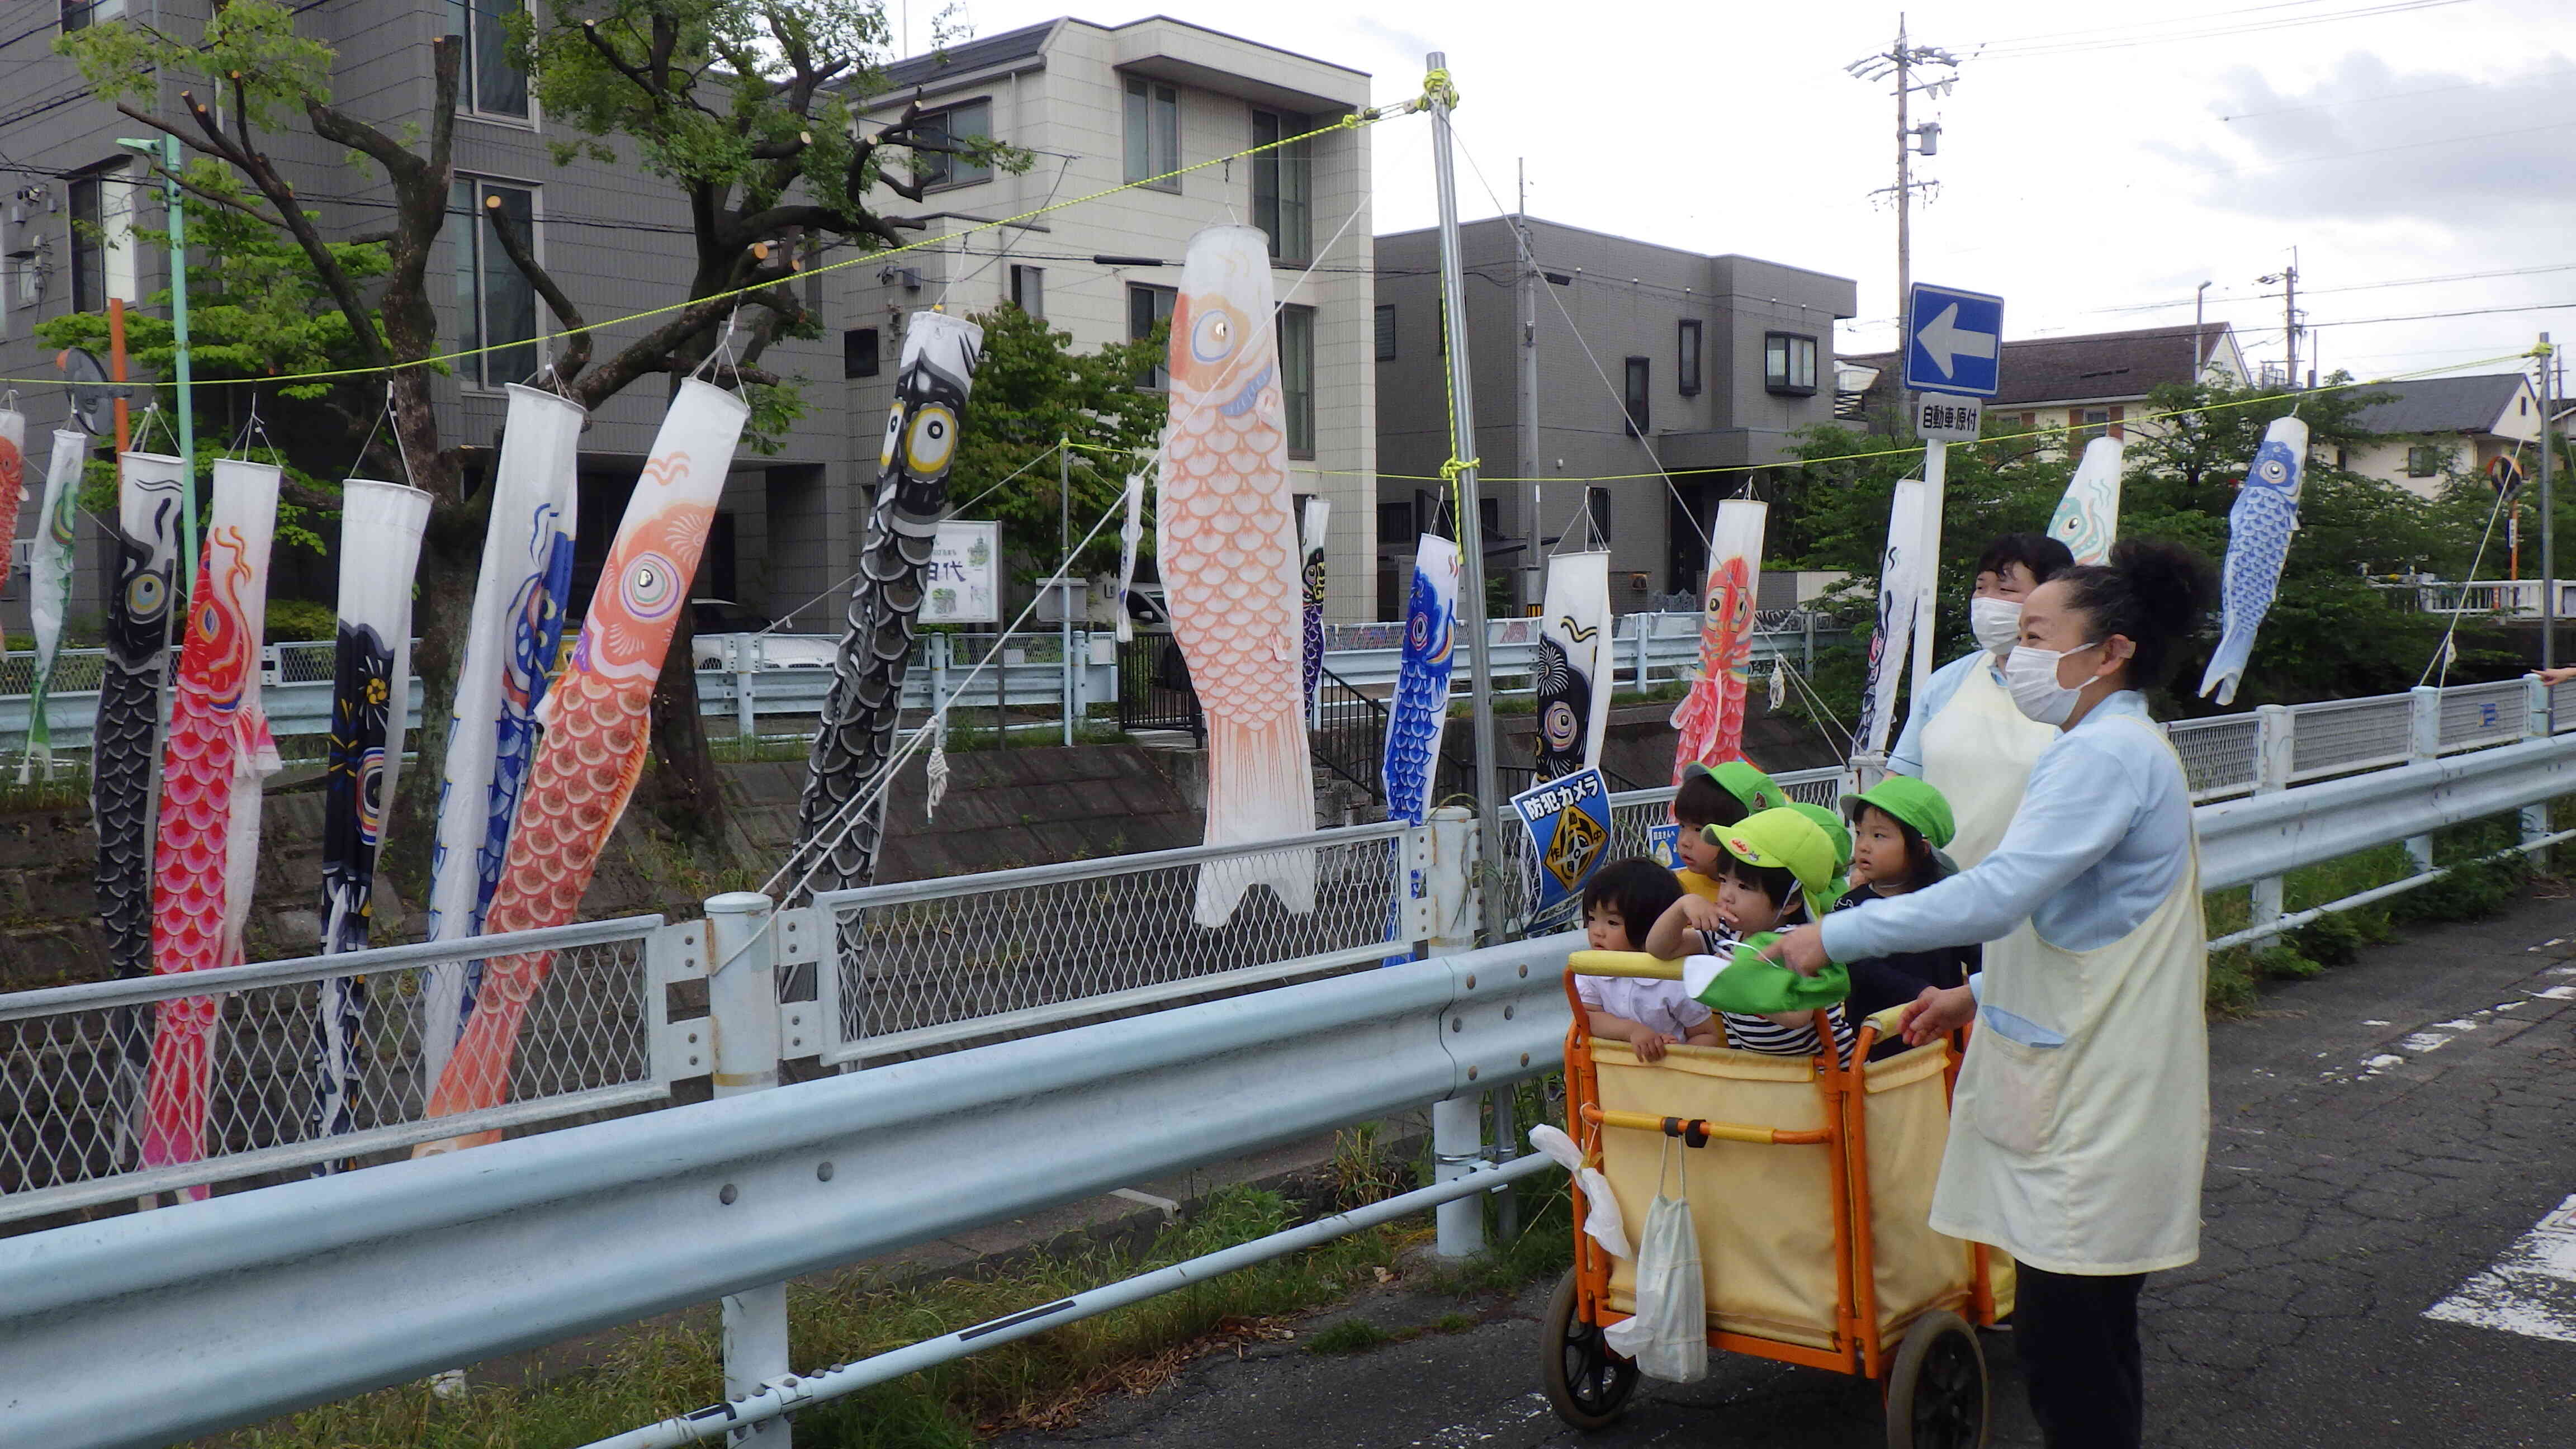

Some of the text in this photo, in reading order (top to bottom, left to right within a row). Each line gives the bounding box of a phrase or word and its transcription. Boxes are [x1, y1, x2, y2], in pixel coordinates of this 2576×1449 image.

[1522, 775, 1598, 821] 防犯カメラ
